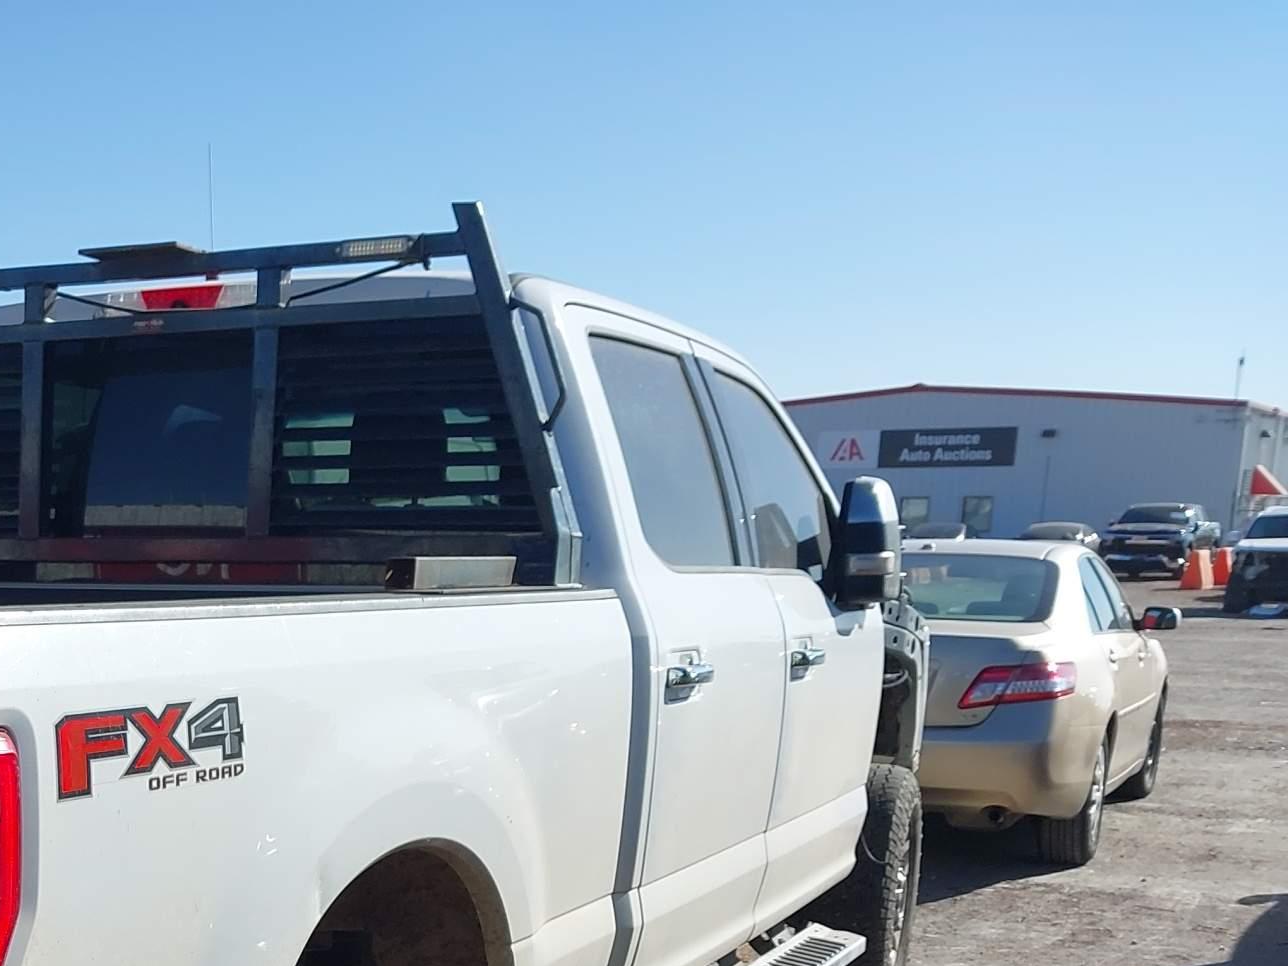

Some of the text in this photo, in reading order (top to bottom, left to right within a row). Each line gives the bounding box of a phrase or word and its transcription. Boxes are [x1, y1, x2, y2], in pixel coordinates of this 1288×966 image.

[914, 433, 981, 447] Insurance
[899, 447, 993, 462] Auto Auctions
[55, 696, 244, 801] FX4
[148, 763, 244, 791] OFF ROAD
